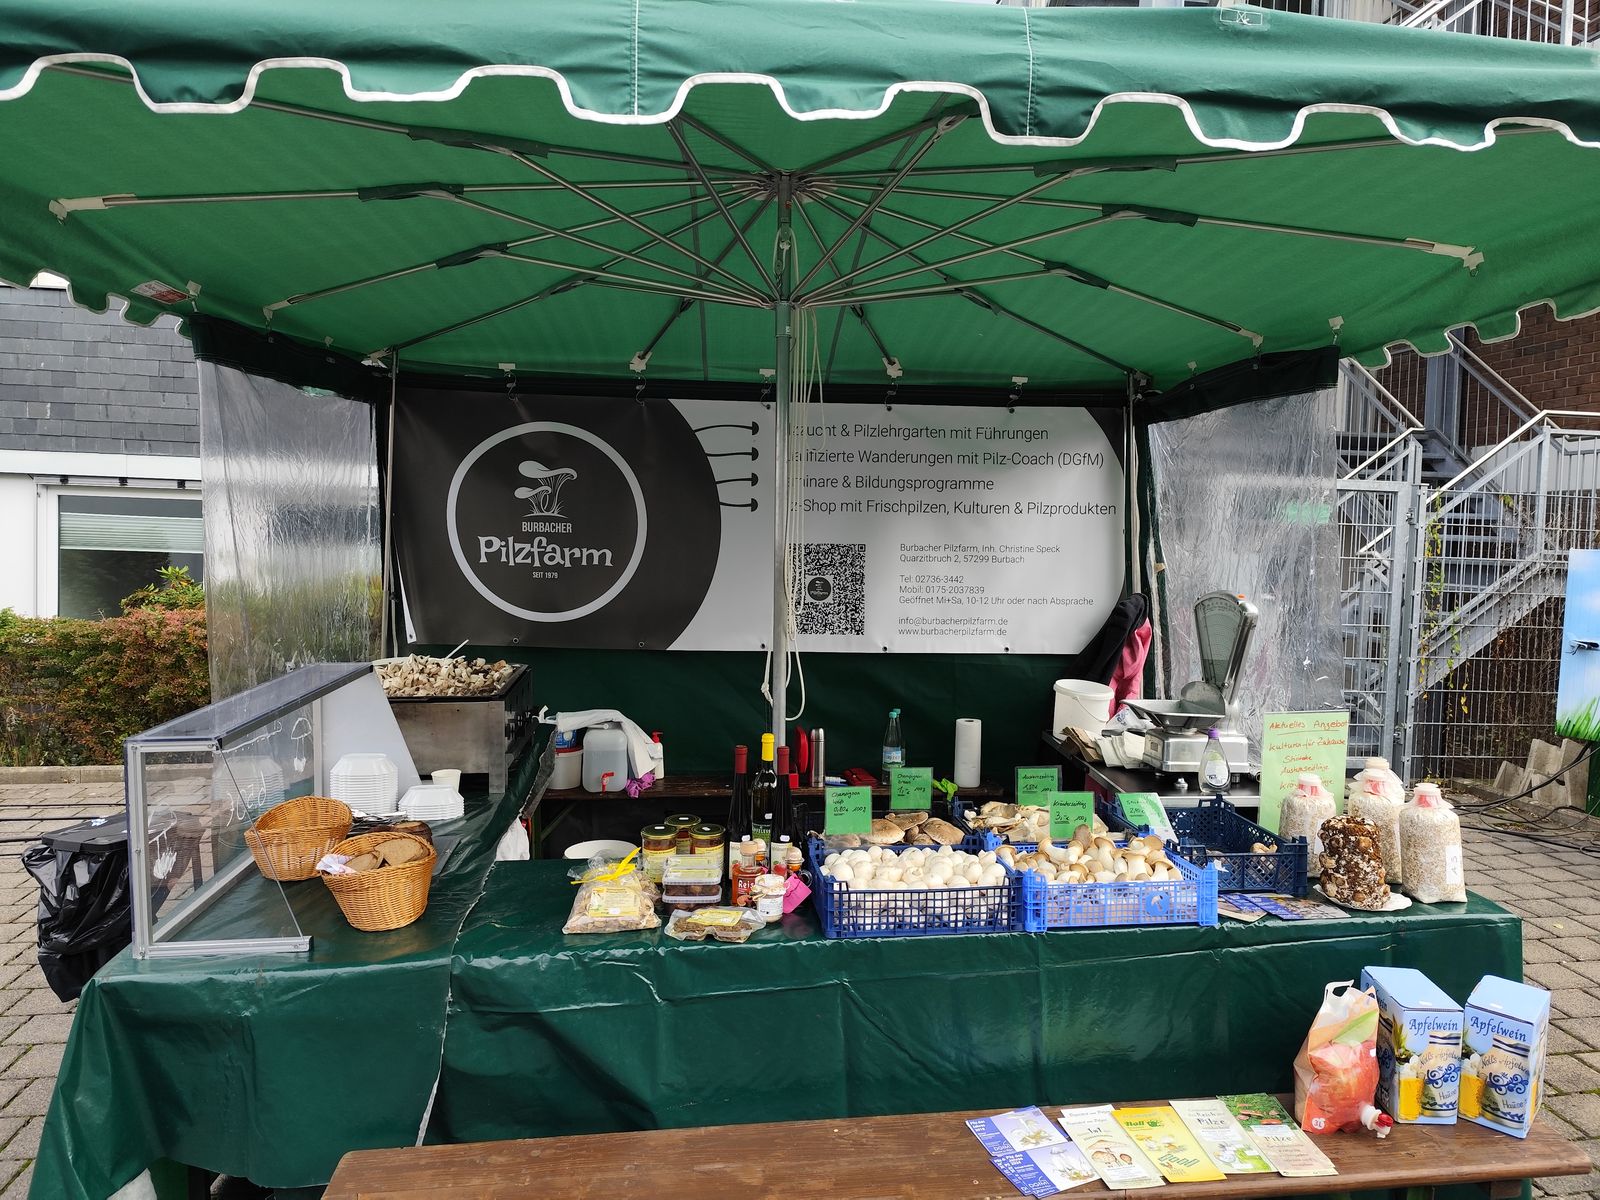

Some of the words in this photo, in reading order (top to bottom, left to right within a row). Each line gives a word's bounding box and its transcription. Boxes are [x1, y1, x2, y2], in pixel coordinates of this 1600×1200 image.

[840, 424, 850, 437] &
[854, 424, 946, 441] Pilzlehrgarten
[950, 426, 972, 439] mit
[976, 426, 1049, 443] Führungen
[858, 450, 953, 467] Wanderungen
[957, 452, 979, 465] mit
[983, 452, 1054, 466] Pilz-Coach
[1057, 452, 1104, 469] (DGfM)
[842, 475, 852, 488] &
[855, 475, 995, 493] Bildungsprogramme
[840, 500, 863, 513] mit
[866, 500, 950, 517] Frischpilzen,
[954, 501, 1010, 515] Kulturen
[1014, 502, 1024, 514] &
[1027, 502, 1117, 519] Pilzprodukten
[521, 521, 572, 534] BURBACHER
[477, 535, 614, 568] Pilzfarm
[900, 543, 942, 553] Burbacher
[943, 543, 980, 554] Pilzfarm,
[982, 545, 996, 554] Inh.
[999, 545, 1034, 554] Christine
[1036, 545, 1061, 556] Speck
[899, 554, 951, 564] Quarzitbruch
[953, 554, 961, 564] 2,
[963, 554, 990, 564] 57299
[991, 554, 1025, 565] Burbach
[532, 571, 544, 579] SEIT
[915, 575, 964, 584] 02736-3442
[899, 585, 924, 594] Mobil:
[925, 585, 985, 595] 0175-2037839
[899, 596, 935, 605] Geöffnet
[966, 596, 989, 606] 10-12
[991, 597, 1004, 606] Uhr
[1007, 597, 1025, 606] oder
[1027, 597, 1048, 606] nach
[1049, 597, 1094, 608] Absprache
[898, 616, 1009, 627] info@burbacherpilzfarm.de
[898, 627, 1008, 637] www.burbacherpilzfarm.de
[1409, 1016, 1459, 1036] Apfelwein
[1470, 1015, 1527, 1042] Apfelwein
